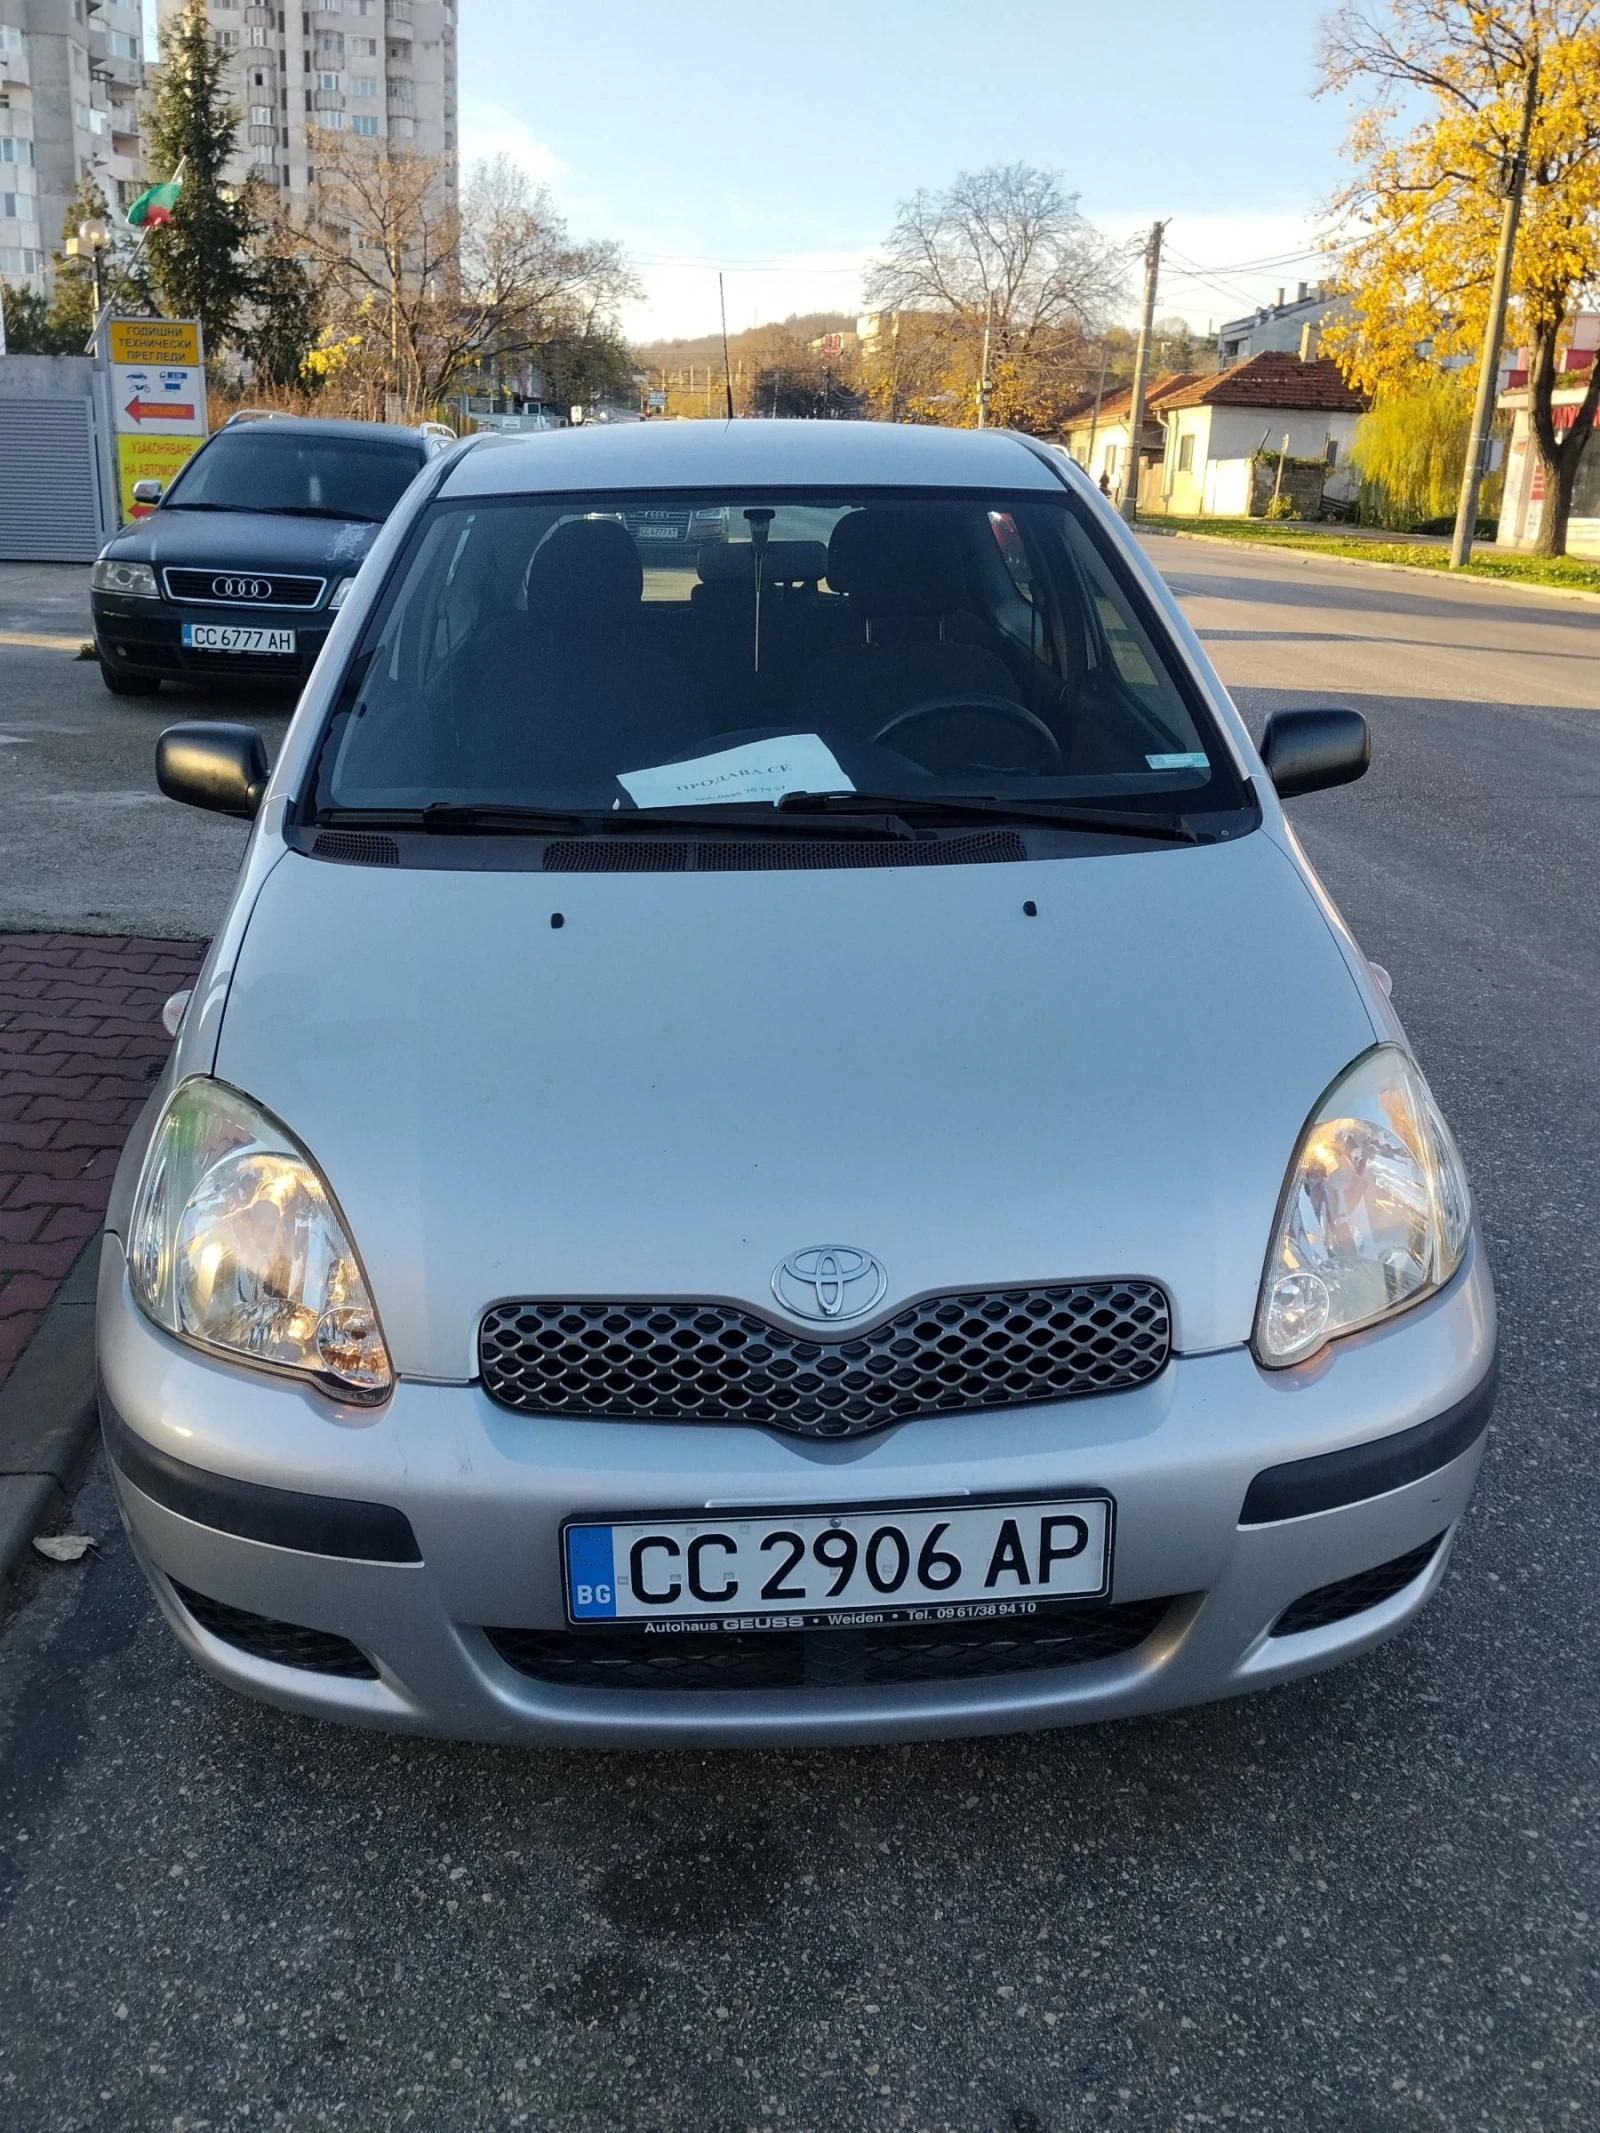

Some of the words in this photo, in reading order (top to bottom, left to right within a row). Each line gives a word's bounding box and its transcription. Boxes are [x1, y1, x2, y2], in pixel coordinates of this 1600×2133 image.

[127, 326, 183, 337] ГОДИШНИ
[118, 338, 192, 349] ТЕХНИЧЕСКИ
[127, 351, 186, 362] ПРЕГЛЕДИ
[124, 463, 136, 475] НА
[139, 463, 180, 477] АВТОМОБ
[194, 627, 217, 646] CC
[221, 629, 263, 648] 6777
[268, 632, 291, 650] AH
[676, 769, 763, 791] ПРОДАВА
[767, 764, 792, 774] СЕ
[630, 1533, 738, 1604] CC
[759, 1523, 963, 1600] 2906
[984, 1515, 1089, 1588] AP
[577, 1584, 611, 1605] BG
[644, 1621, 718, 1634] Autohaus
[723, 1616, 804, 1630] GEUSS
[828, 1613, 884, 1625] Weiden
[907, 1610, 932, 1621] Tel.
